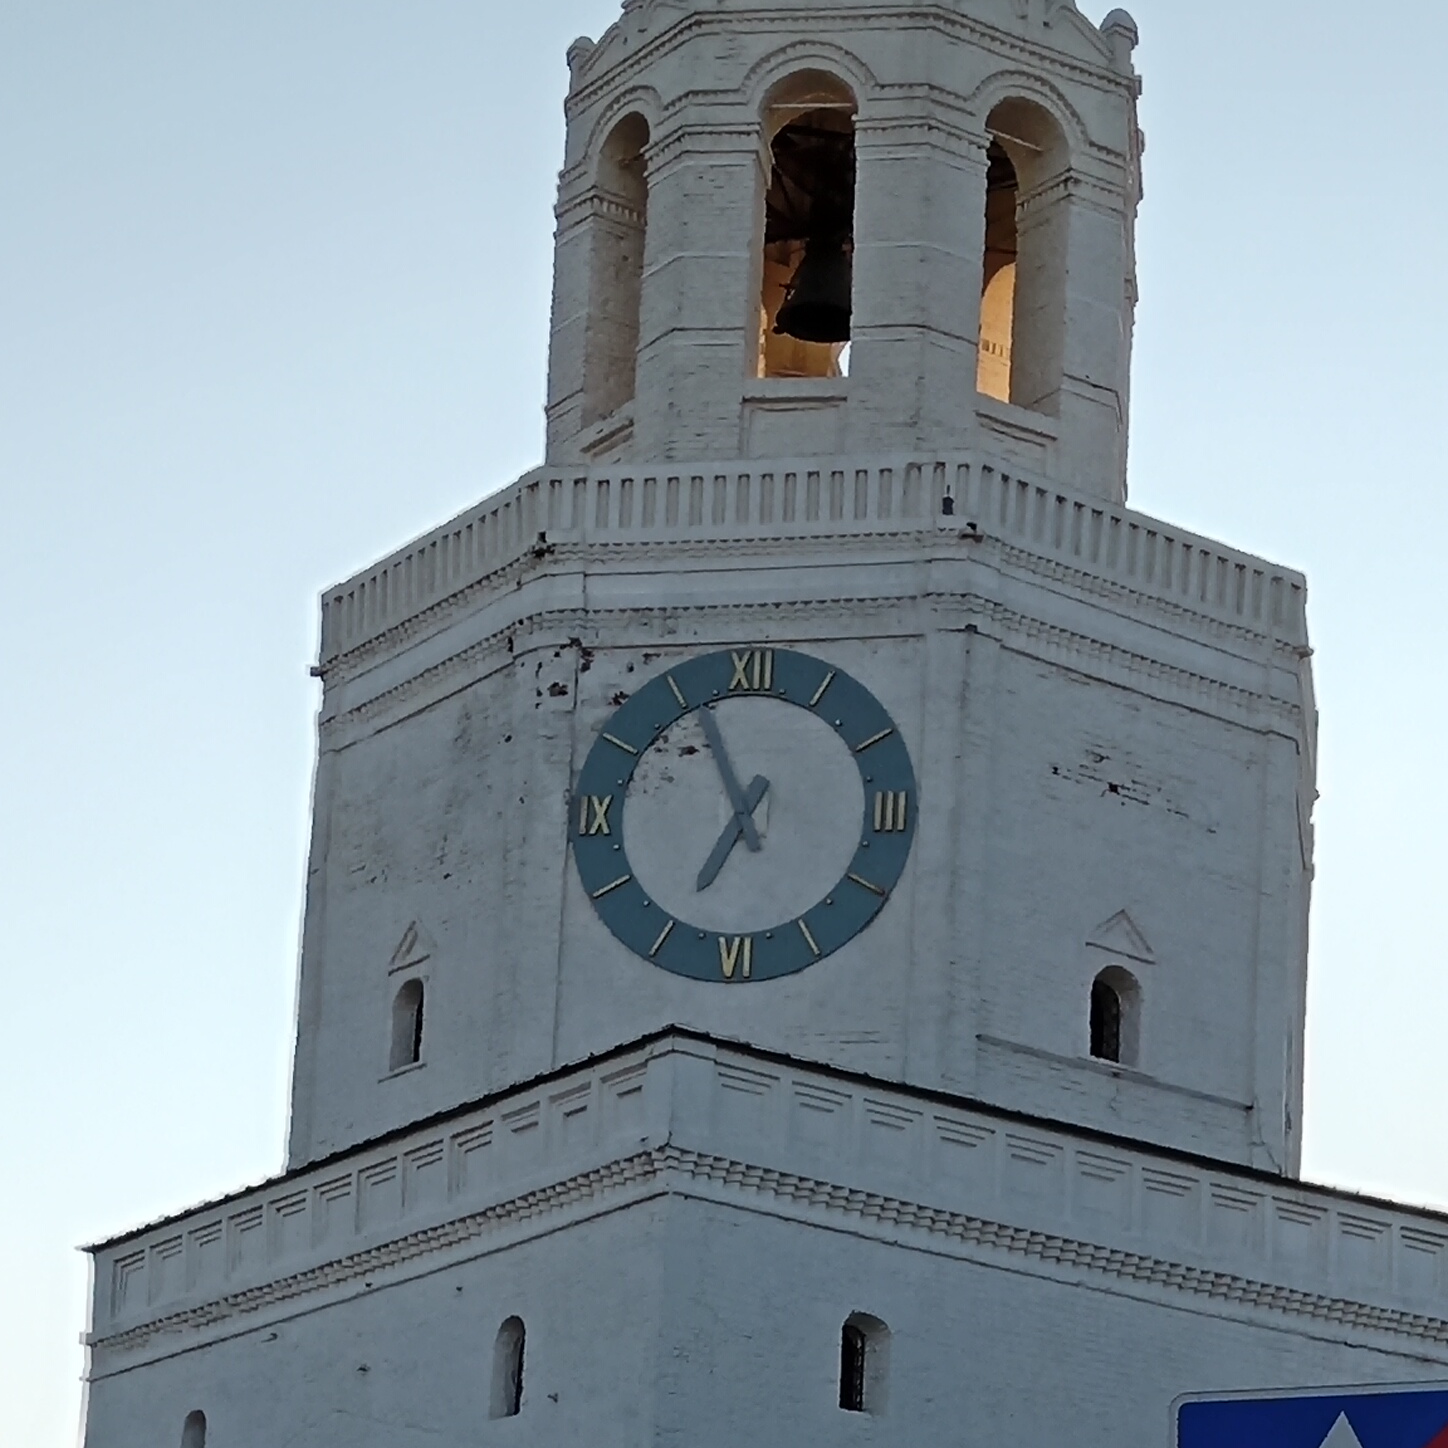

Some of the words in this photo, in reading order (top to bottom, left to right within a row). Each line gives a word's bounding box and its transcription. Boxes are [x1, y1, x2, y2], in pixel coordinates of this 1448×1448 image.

[728, 649, 773, 690] XII
[579, 793, 613, 835] IX
[874, 790, 906, 831] III
[718, 936, 752, 978] VI
